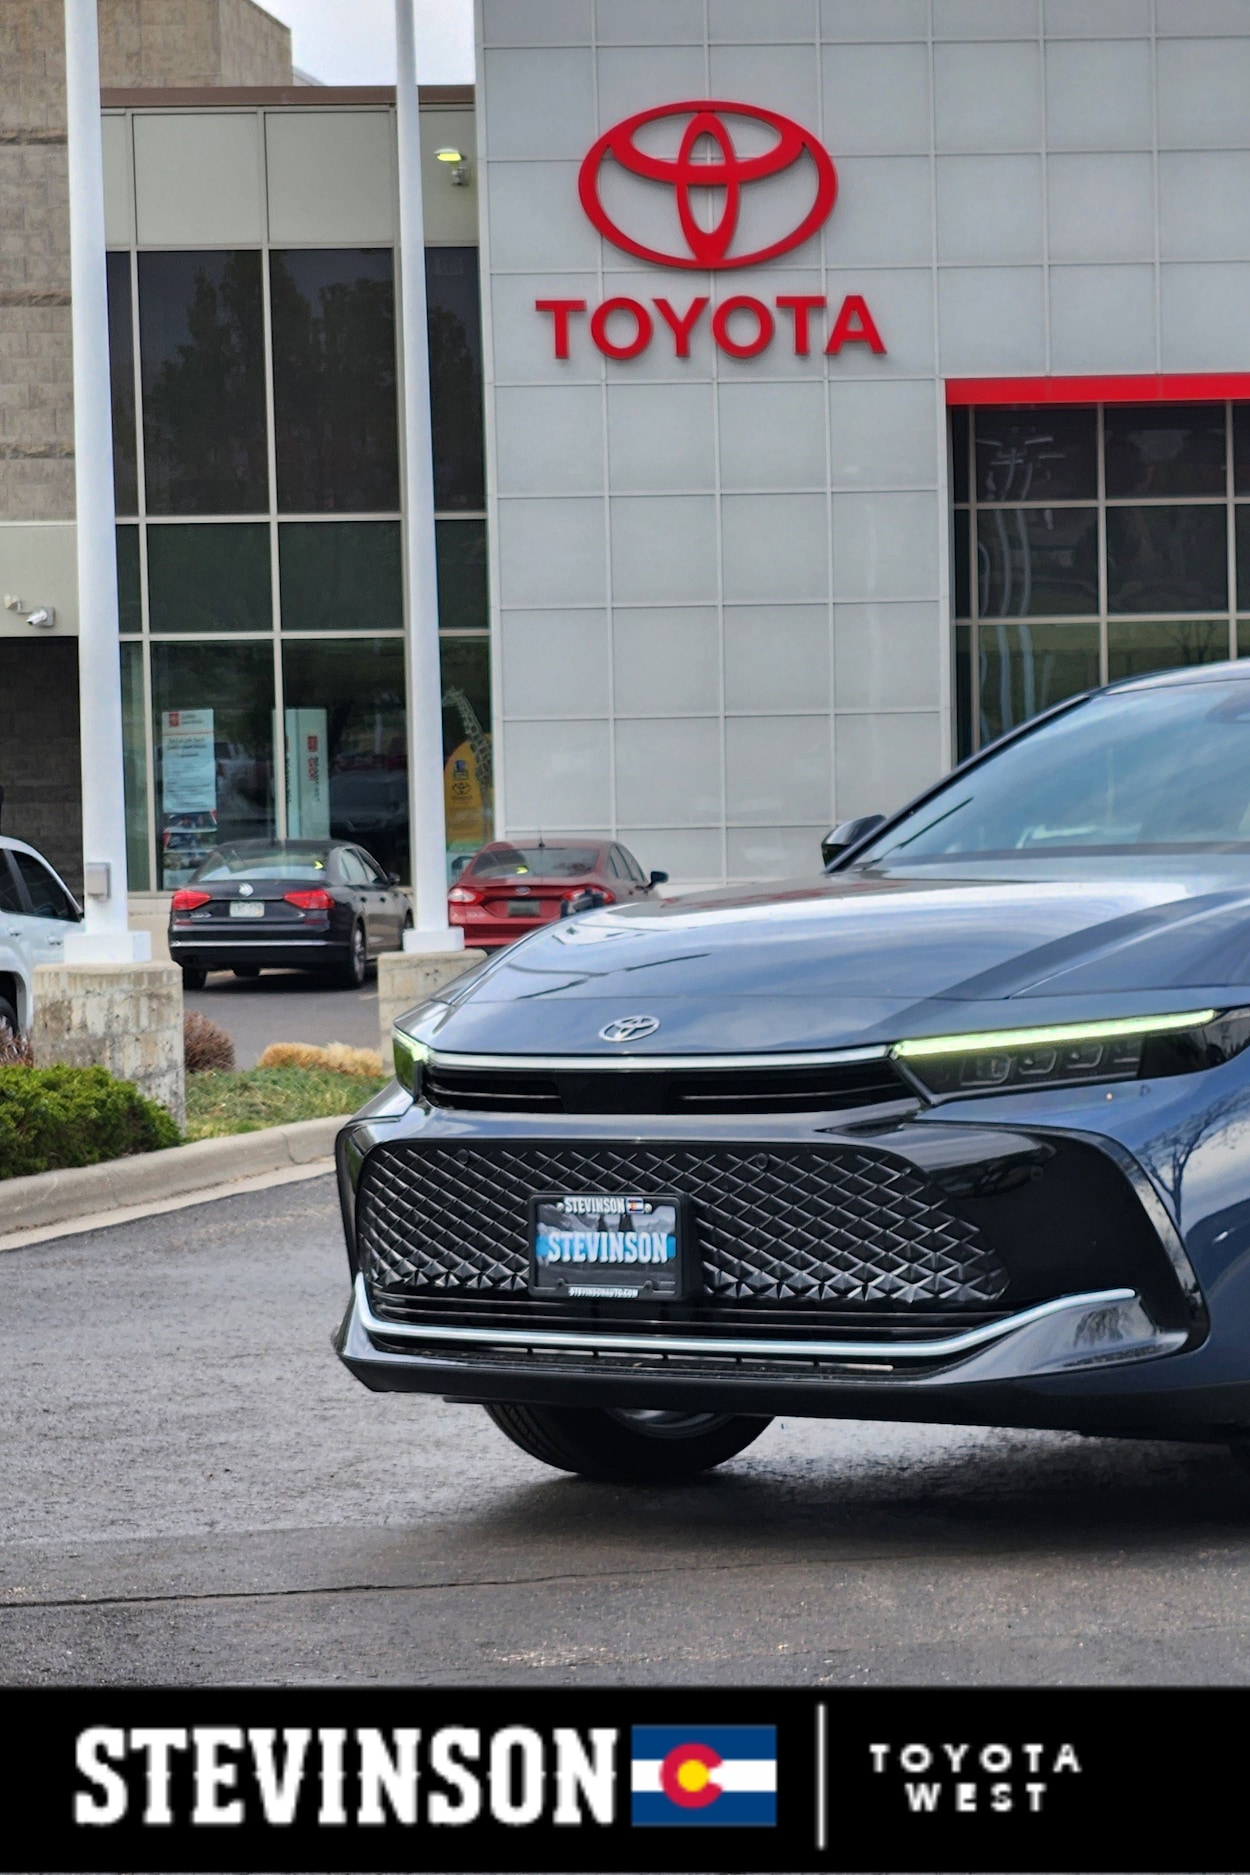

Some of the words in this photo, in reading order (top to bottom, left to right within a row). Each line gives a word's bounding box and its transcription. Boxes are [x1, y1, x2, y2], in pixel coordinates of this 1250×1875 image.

[534, 295, 887, 361] TOYOTA
[563, 1197, 625, 1214] STEVINSON
[548, 1232, 668, 1264] STEVINSON
